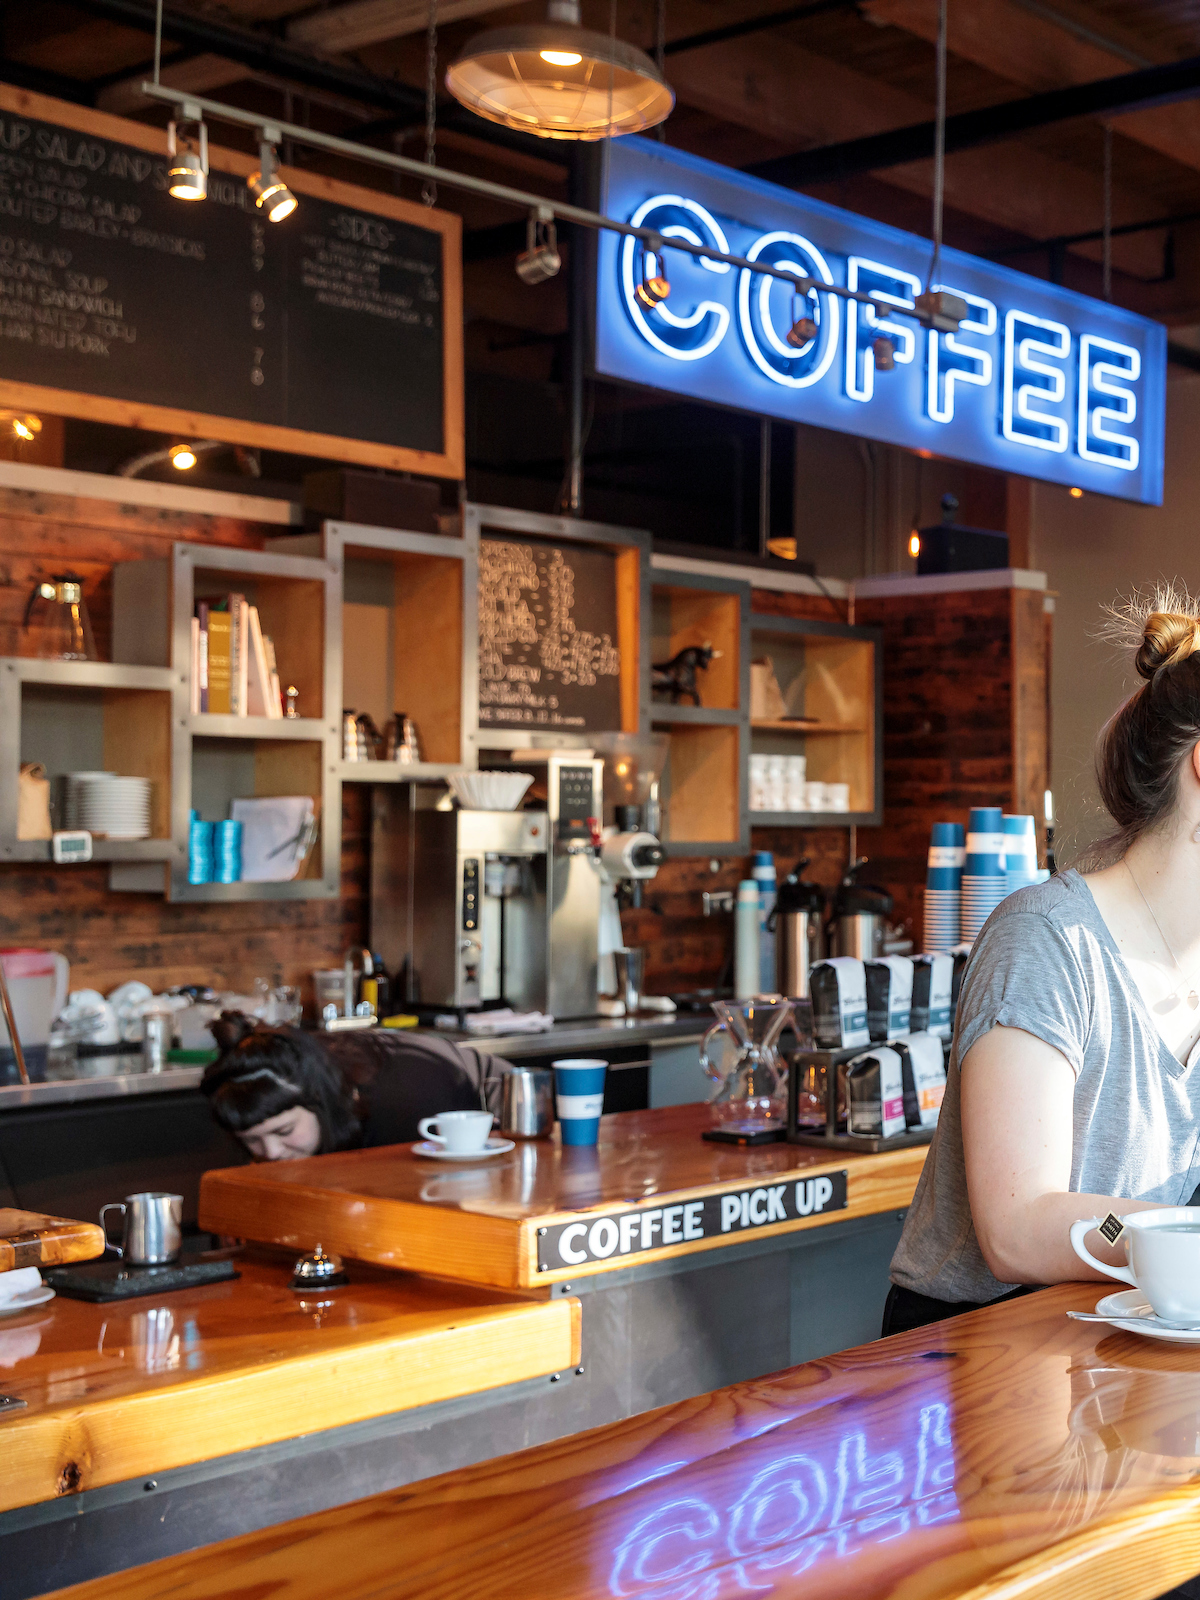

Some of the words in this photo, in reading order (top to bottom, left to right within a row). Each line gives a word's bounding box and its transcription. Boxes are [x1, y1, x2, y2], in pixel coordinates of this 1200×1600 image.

[622, 194, 1141, 471] COFFEE
[558, 1201, 705, 1265] COFFEE
[720, 1184, 788, 1233] PICK
[794, 1176, 834, 1217] UP
